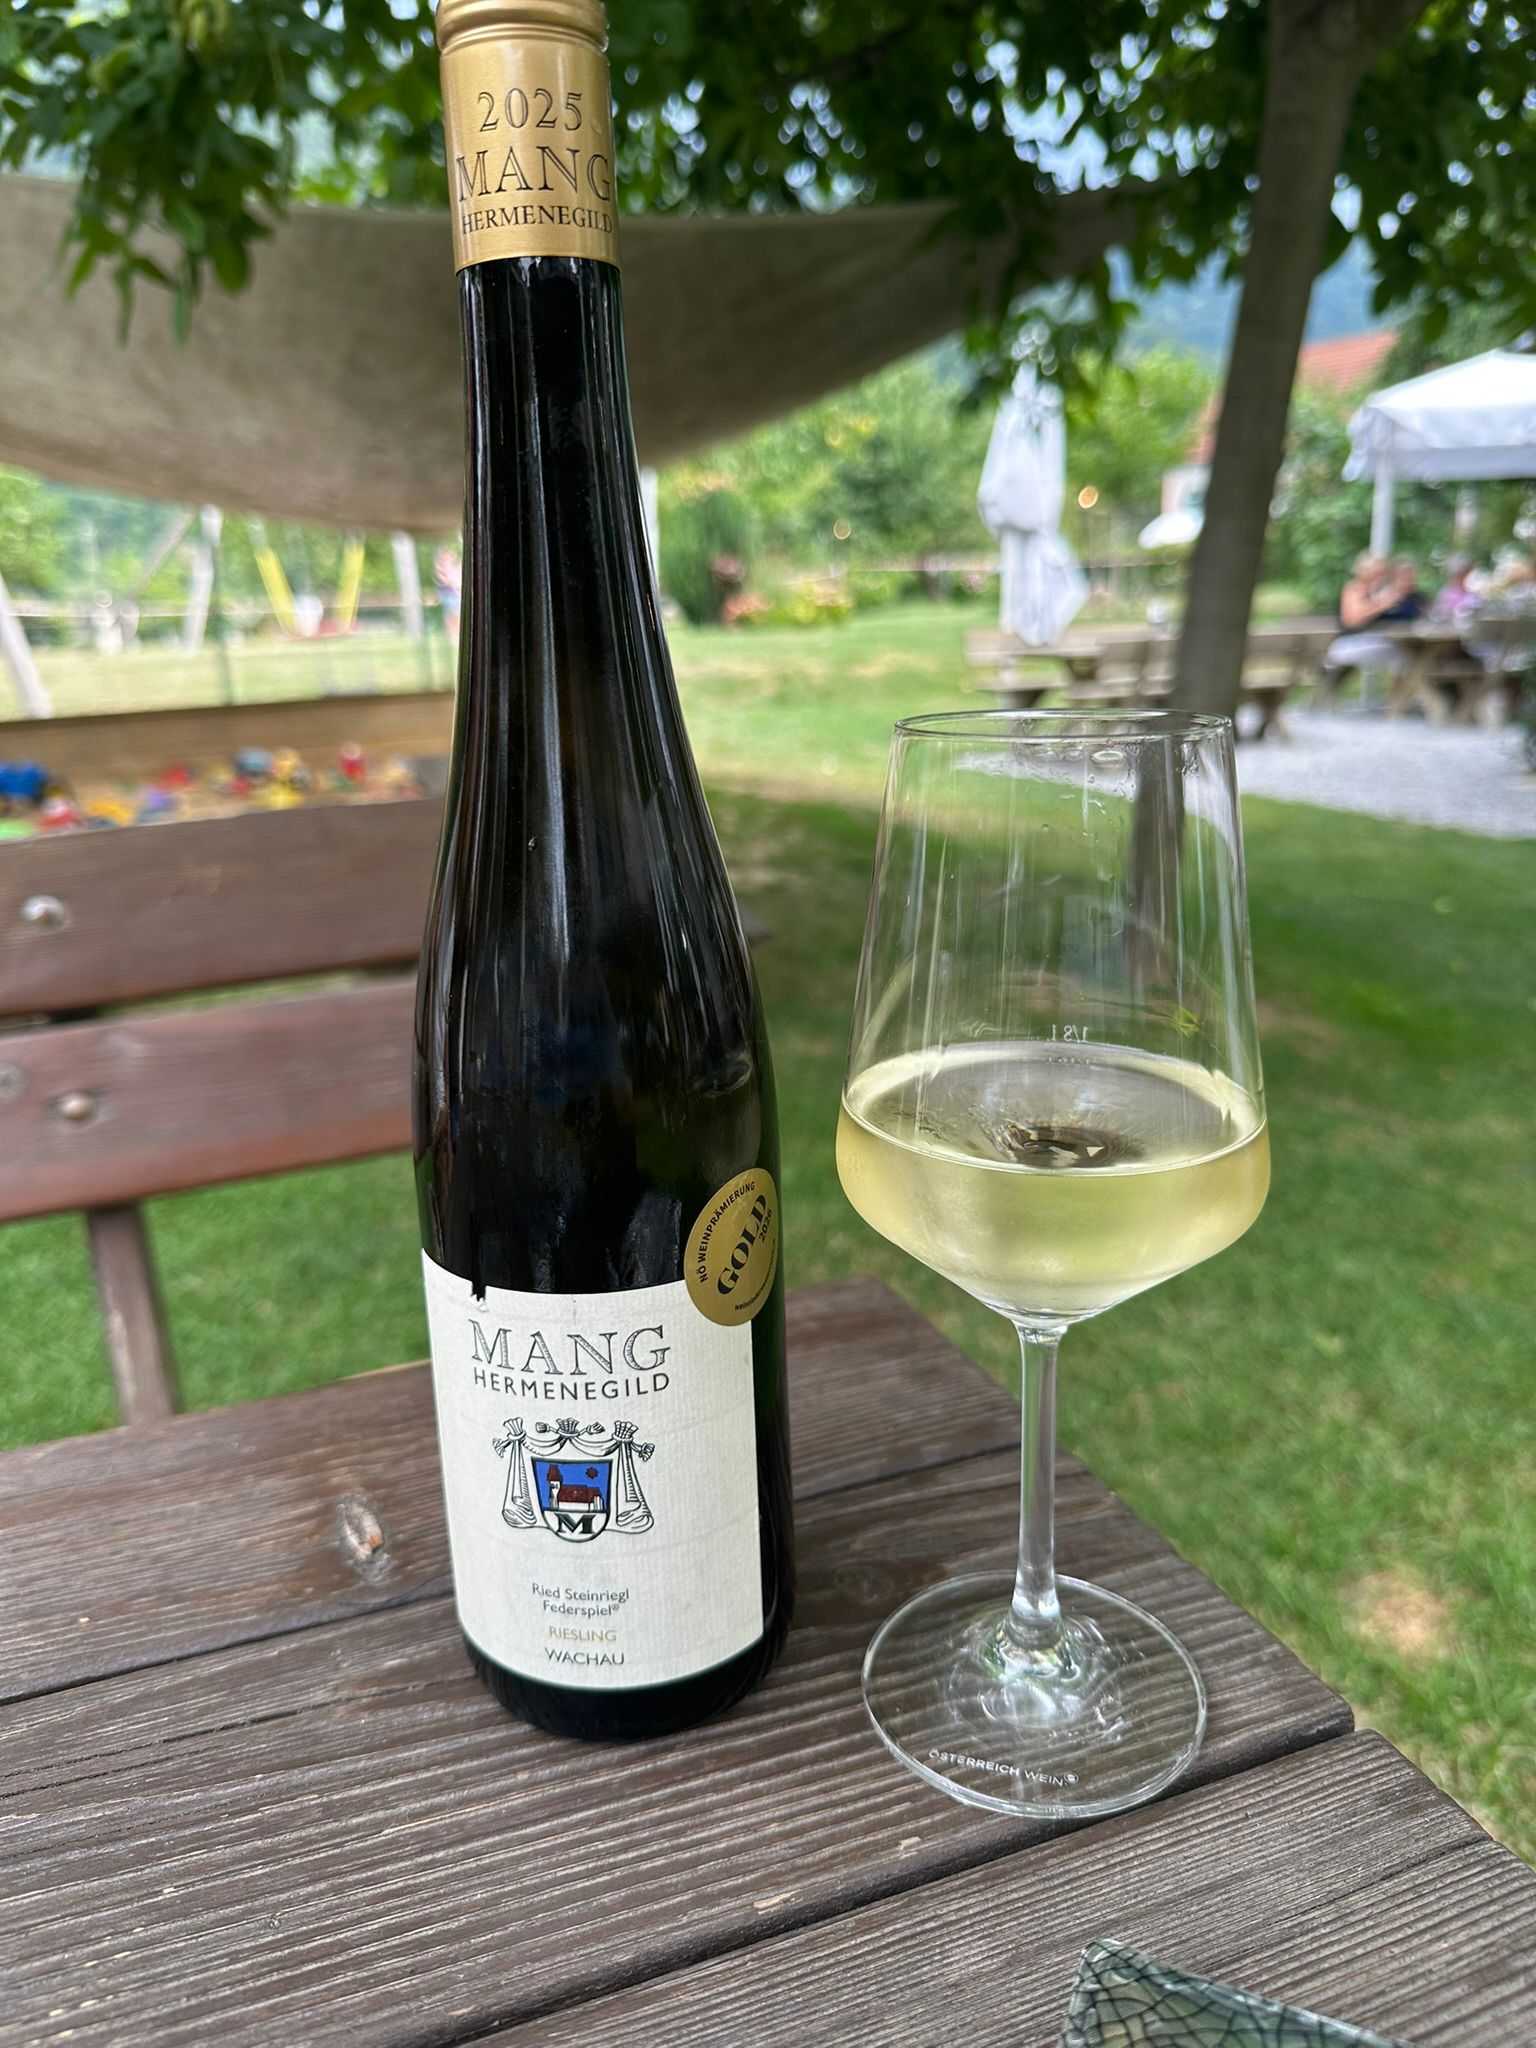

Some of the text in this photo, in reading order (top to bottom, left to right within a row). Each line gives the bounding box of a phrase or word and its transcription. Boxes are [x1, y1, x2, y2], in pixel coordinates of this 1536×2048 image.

[478, 88, 582, 132] 2025
[456, 146, 611, 202] MANG
[462, 205, 613, 235] HERMENEGILD
[698, 1181, 756, 1264] WEINPRÄMIERUNG
[717, 1194, 768, 1295] GOLD
[696, 1266, 708, 1283] NÖ
[468, 1318, 671, 1376] MANG
[473, 1366, 670, 1400] HERMENEGILD
[557, 1513, 597, 1535] M
[532, 1582, 629, 1603] Ried Steinriegl
[549, 1625, 617, 1642] RIESLING
[544, 1647, 624, 1666] WACHAU
[928, 1748, 1020, 1777] ÖSTERREICH
